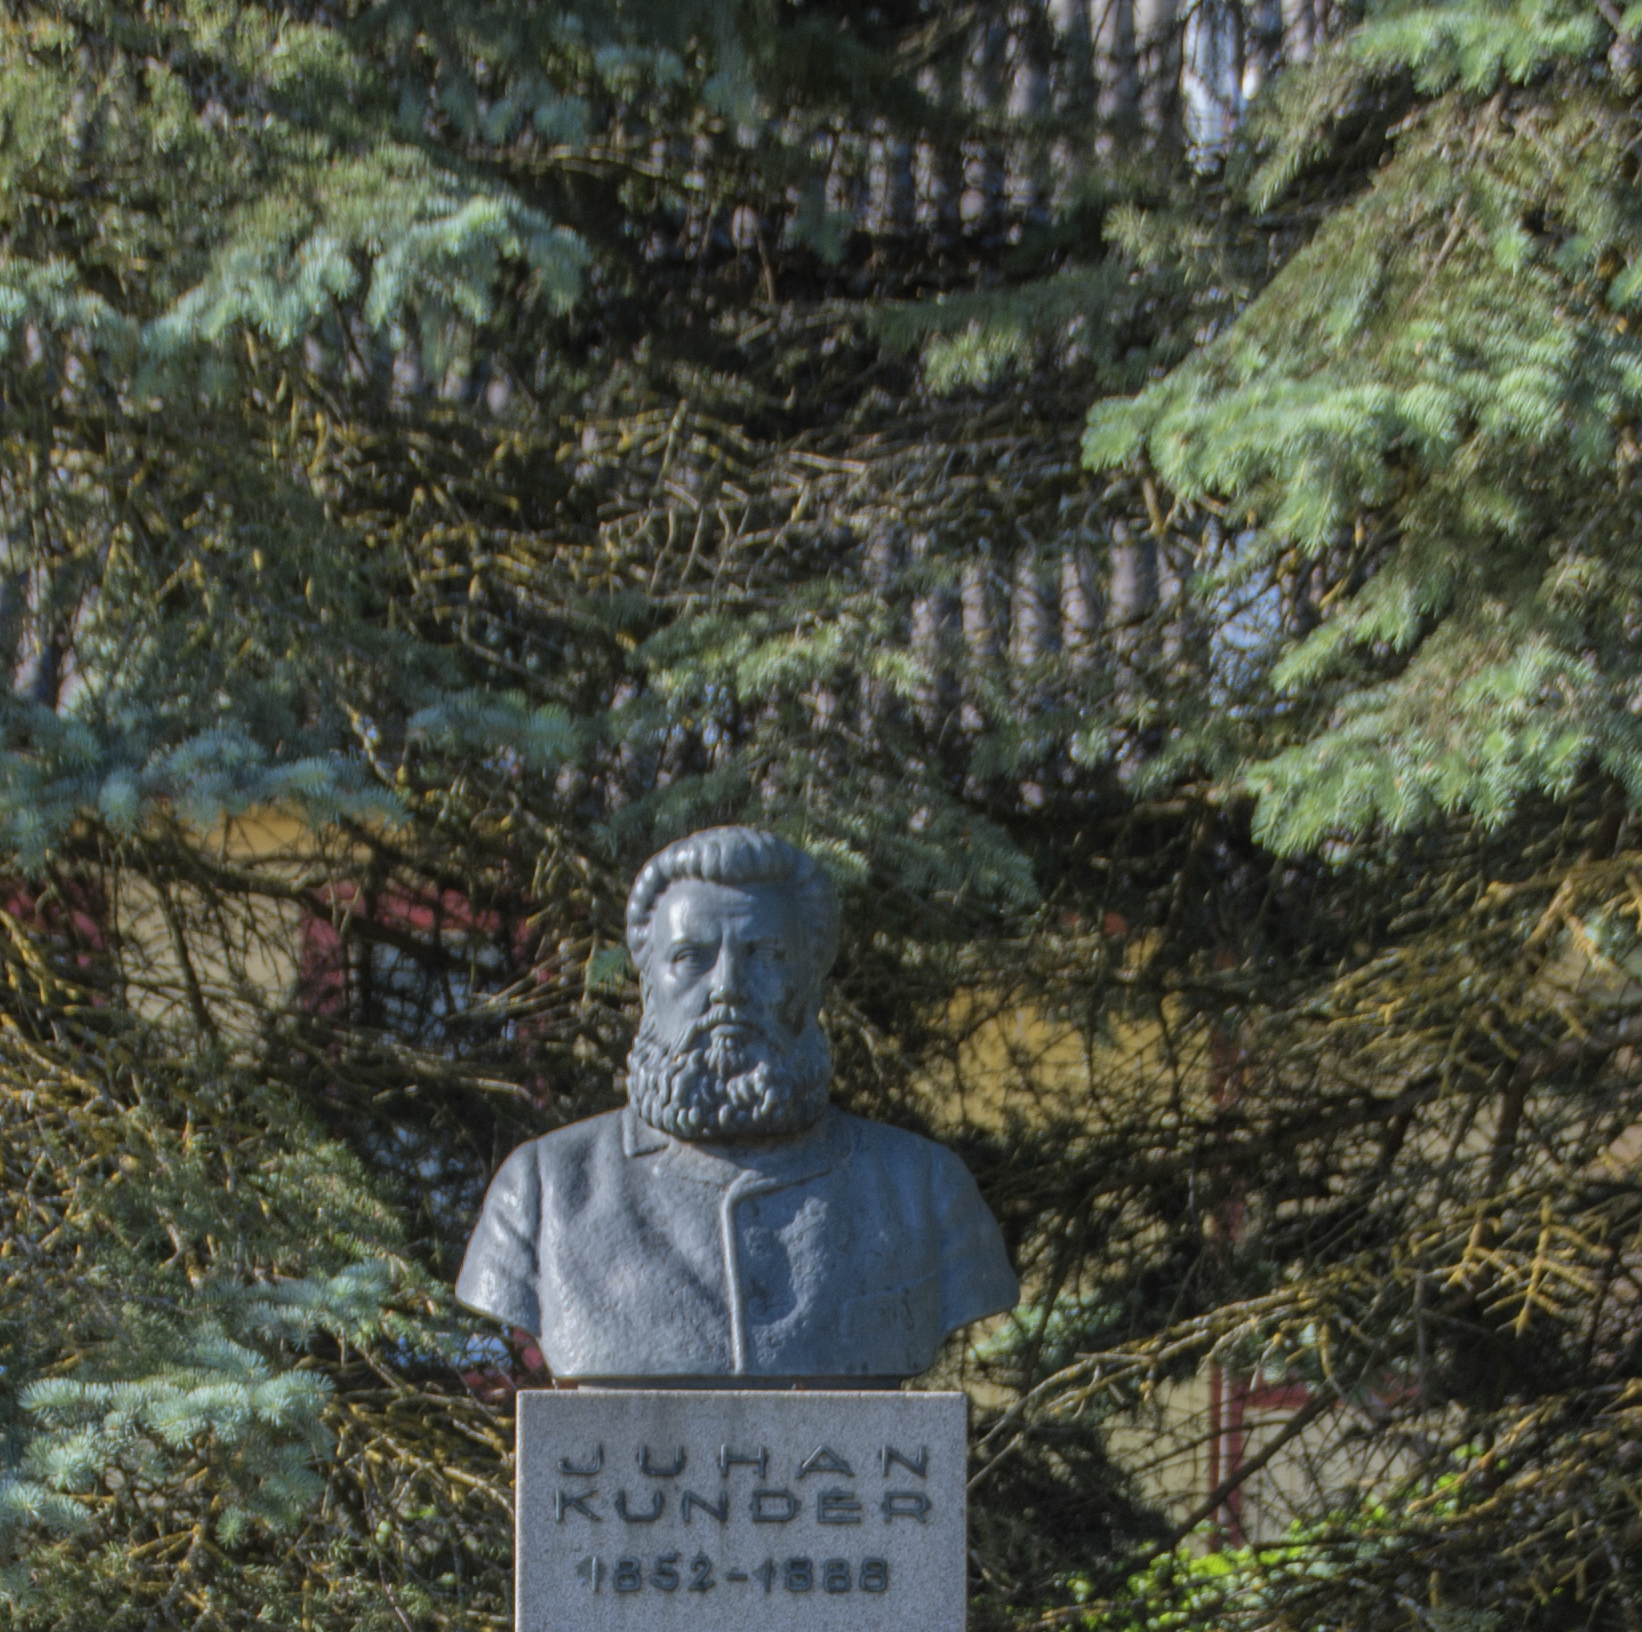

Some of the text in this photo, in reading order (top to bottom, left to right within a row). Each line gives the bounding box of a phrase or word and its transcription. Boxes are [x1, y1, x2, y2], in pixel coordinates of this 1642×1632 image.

[558, 1443, 930, 1478] JUHAN
[555, 1489, 932, 1524] KUNDER
[587, 1553, 890, 1594] 1852-1888
